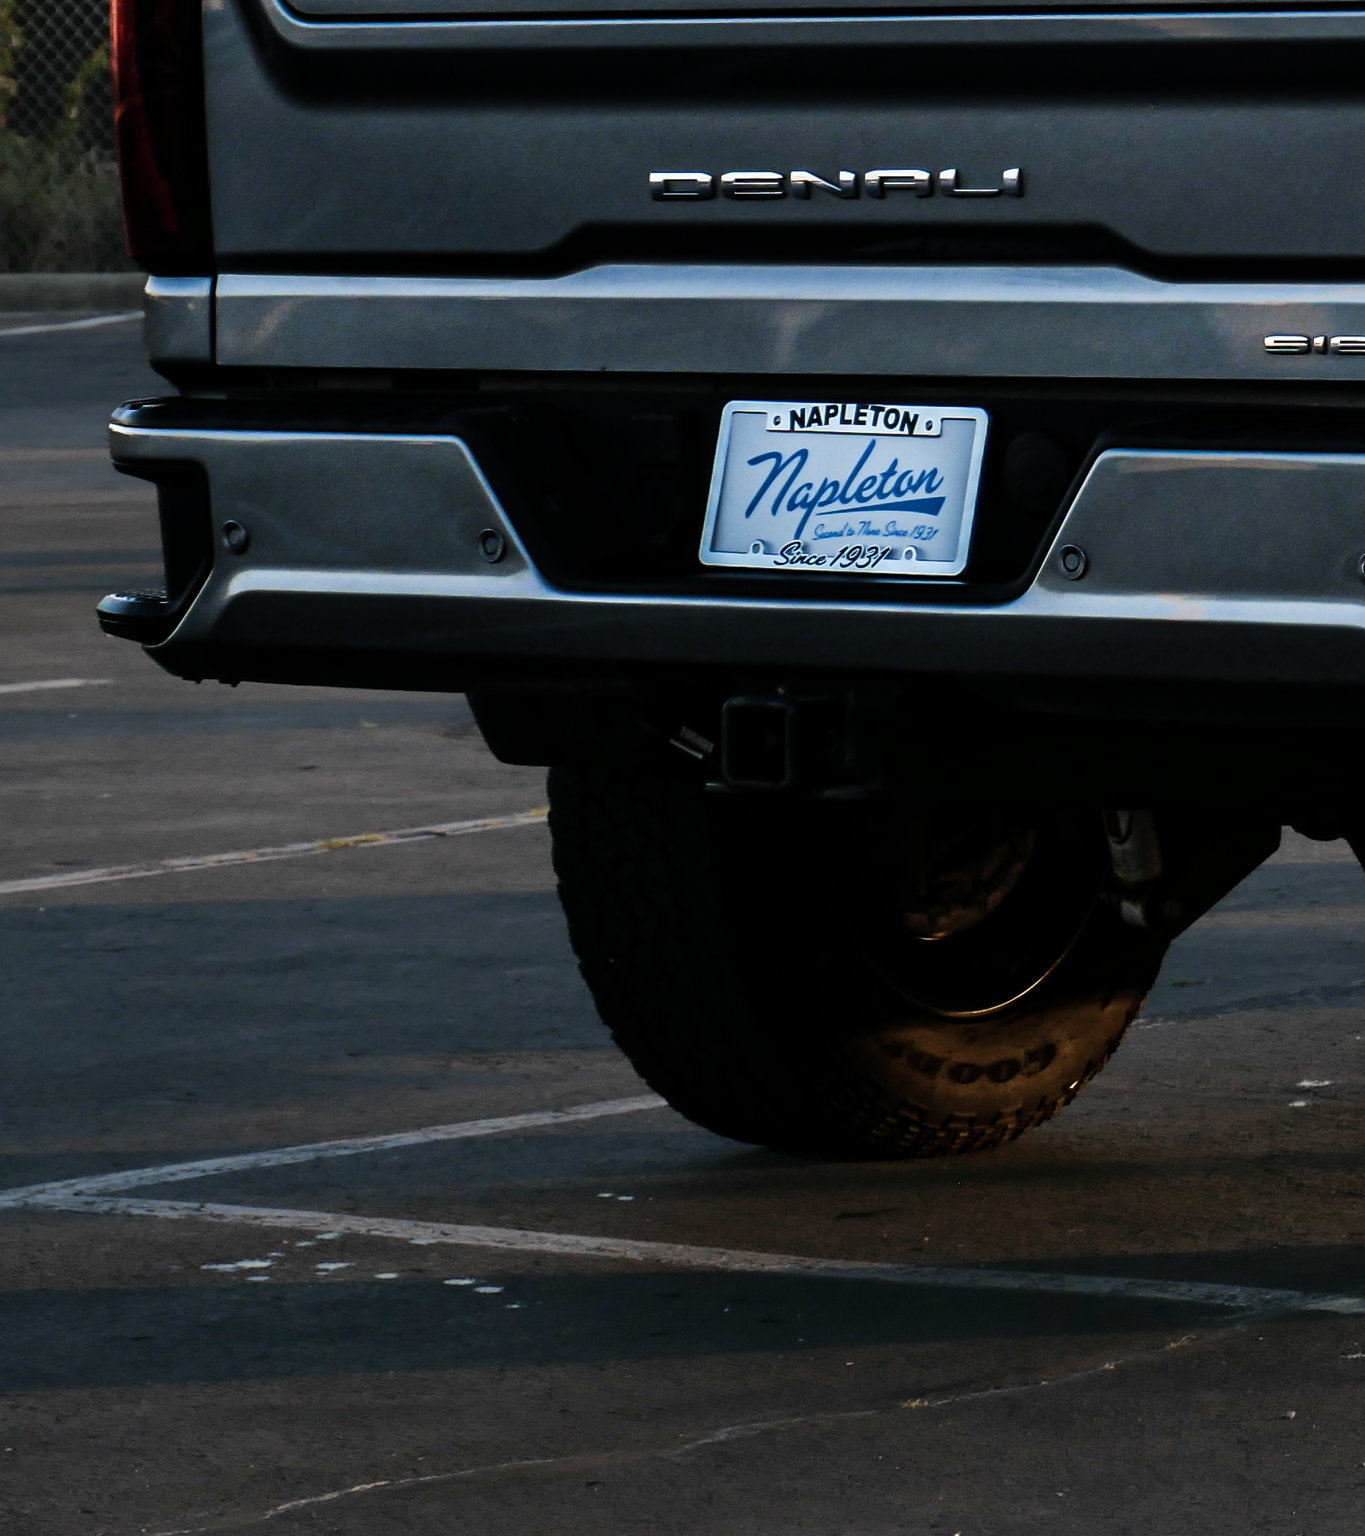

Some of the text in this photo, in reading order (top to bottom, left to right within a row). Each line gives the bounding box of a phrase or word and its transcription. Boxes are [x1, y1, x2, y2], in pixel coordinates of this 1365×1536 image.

[649, 168, 1022, 201] DENALI
[789, 404, 919, 434] NAPLETON
[745, 439, 944, 539] Napleton
[909, 525, 940, 541] 1931
[774, 541, 891, 569] Since 1931
